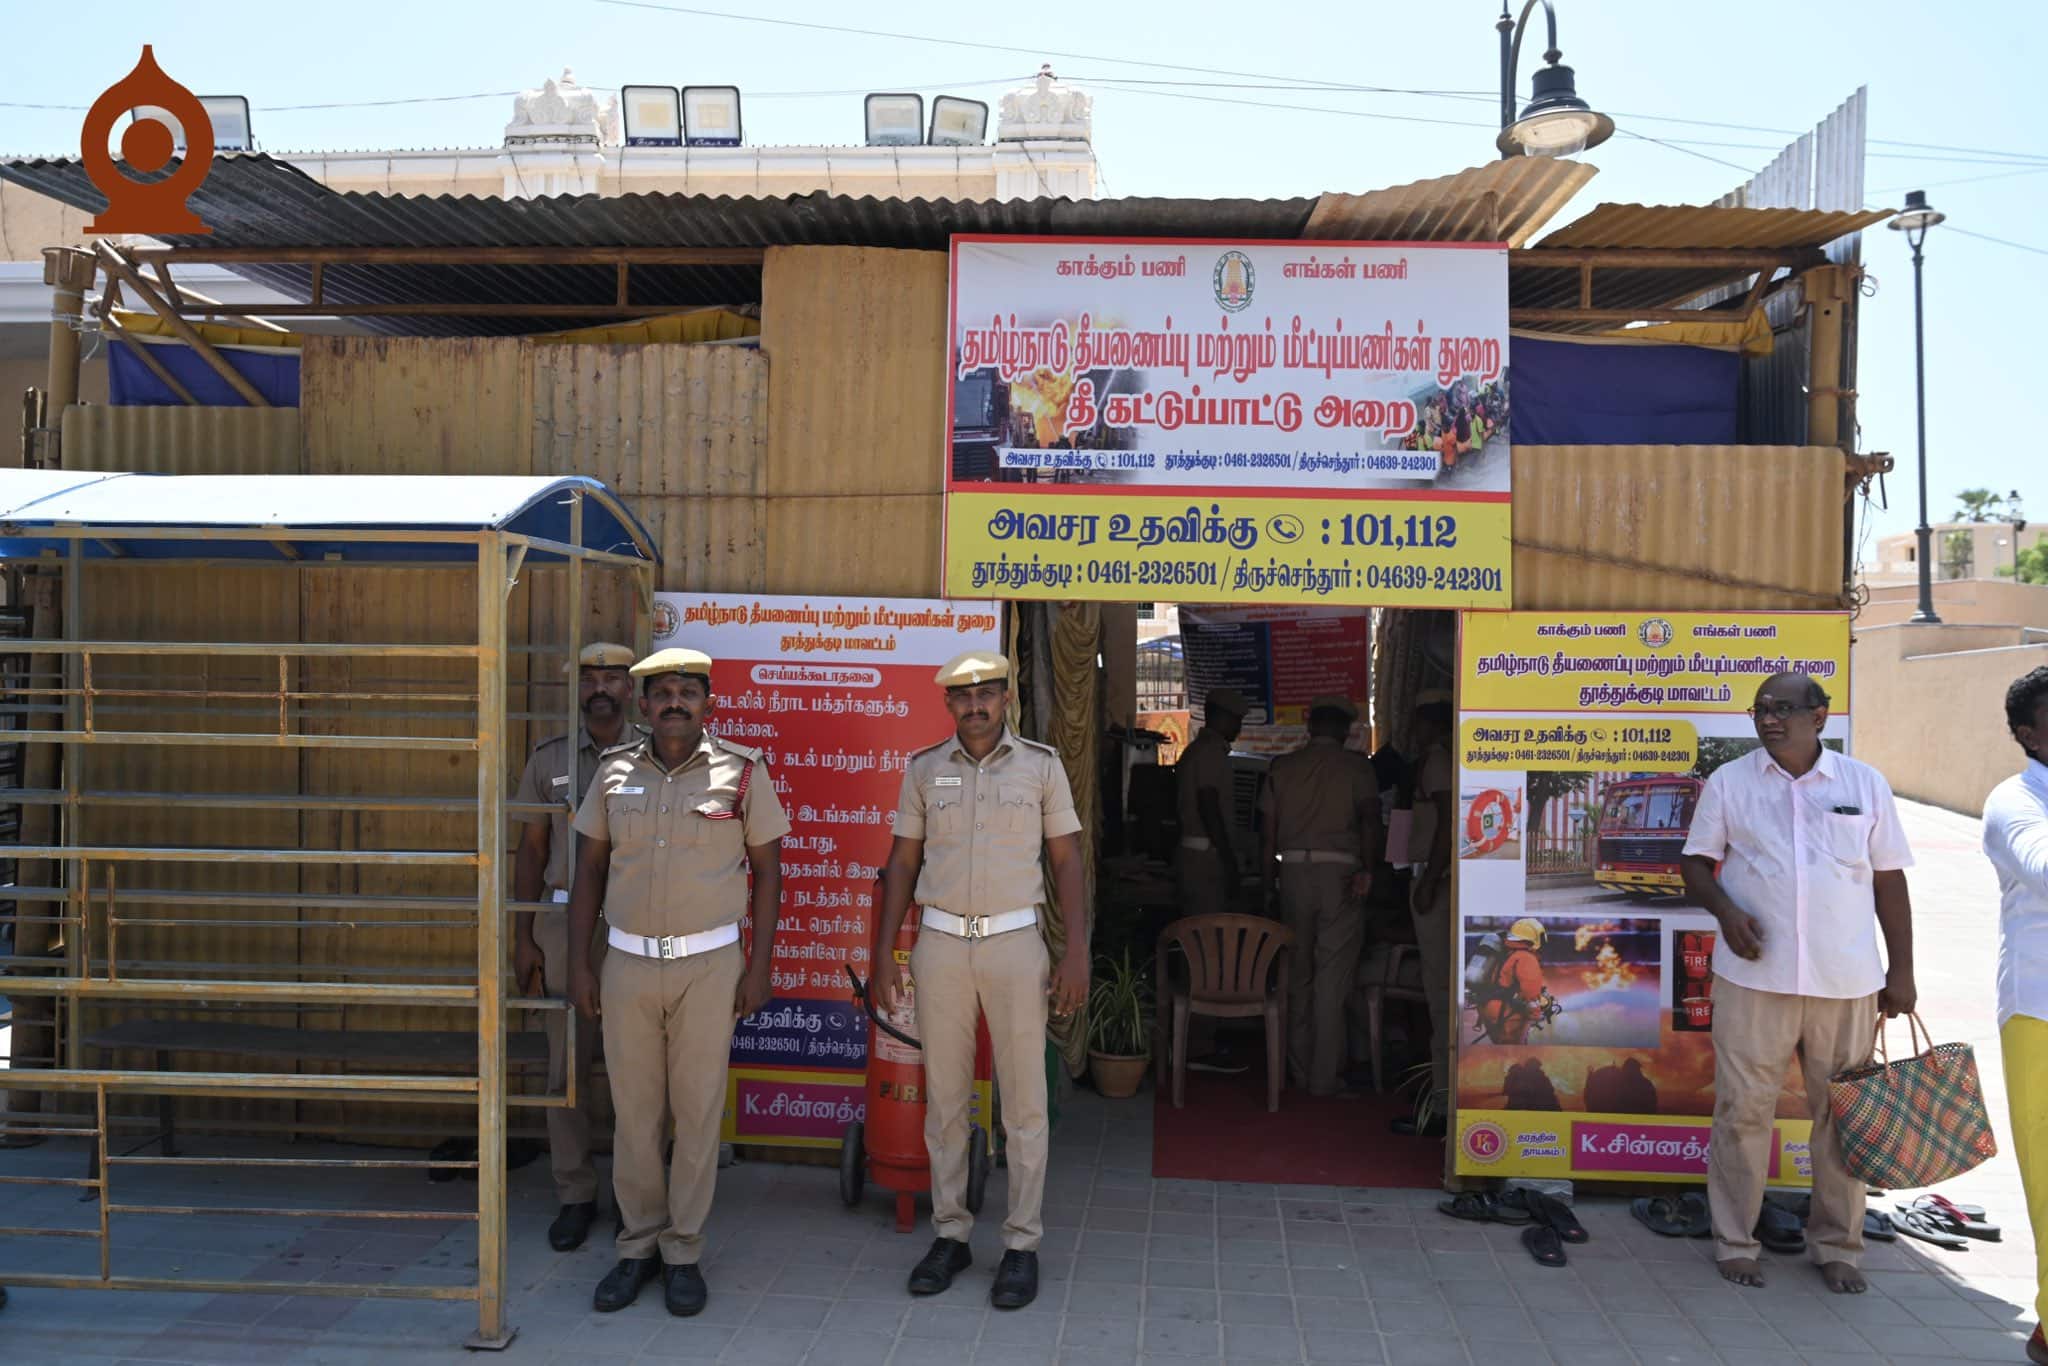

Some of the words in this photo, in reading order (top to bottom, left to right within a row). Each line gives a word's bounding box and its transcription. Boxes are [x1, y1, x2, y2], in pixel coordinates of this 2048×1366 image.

[1056, 254, 1135, 279] காக்கும்
[1142, 255, 1186, 277] பணி
[1283, 256, 1356, 279] எங்கள்
[1363, 258, 1408, 279] பணி
[960, 313, 1069, 380] தமிழ்நாடு
[1074, 312, 1189, 378] தீயணைப்பு
[1196, 315, 1276, 383] மற்றும்
[1283, 315, 1432, 379] மீட்புப்பணிகள்
[1438, 336, 1500, 386] துறை
[1066, 382, 1096, 431] தீ
[1107, 385, 1303, 432] கட்டுப்பாட்டு
[1314, 395, 1416, 440] அறை
[1005, 452, 1042, 468] அவசர
[1044, 451, 1092, 468] உதவிக்கு
[988, 508, 1100, 546] அவசர
[1108, 504, 1258, 550] உதவிக்கு
[972, 552, 1072, 589] தூத்துக்குடி
[1087, 559, 1217, 585] 0461-2326501
[1233, 557, 1352, 595] திருச்செந்தூர்
[1366, 564, 1503, 592] 04639-242301
[684, 601, 748, 627] தமிழ்நாடு
[750, 601, 820, 627] தீயணைப்பு
[823, 604, 871, 629] மற்றும்
[957, 614, 996, 633] துறை
[780, 631, 842, 652] தூத்துக்குடி
[844, 634, 896, 651] மாவட்டம்
[1537, 623, 1591, 638] காக்கும்
[1595, 624, 1626, 636] பணி
[1693, 624, 1741, 638] எங்கள்
[1744, 625, 1776, 638] பணி
[758, 666, 875, 685] செய்யக்கூடாதவை
[1477, 653, 1549, 677] தமிழ்நாடு
[1551, 651, 1633, 676] தீயணைப்பு
[1636, 654, 1685, 677] மற்றும்
[1688, 652, 1789, 676] மீட்புப்பணிகள்
[768, 690, 808, 713] நீராட
[812, 692, 909, 717] பக்தர்களுக்கு
[1579, 683, 1664, 706] தூத்துக்குடி
[1668, 684, 1732, 702] மாவட்டம்
[1473, 727, 1520, 743] அவசர
[1524, 725, 1588, 745] உதவிக்கு
[784, 747, 818, 768] கடல்
[821, 748, 876, 773] மற்றும்
[798, 803, 881, 825] இடங்களின்
[810, 915, 865, 935] நெரிசல்
[1684, 956, 1708, 967] FIRE
